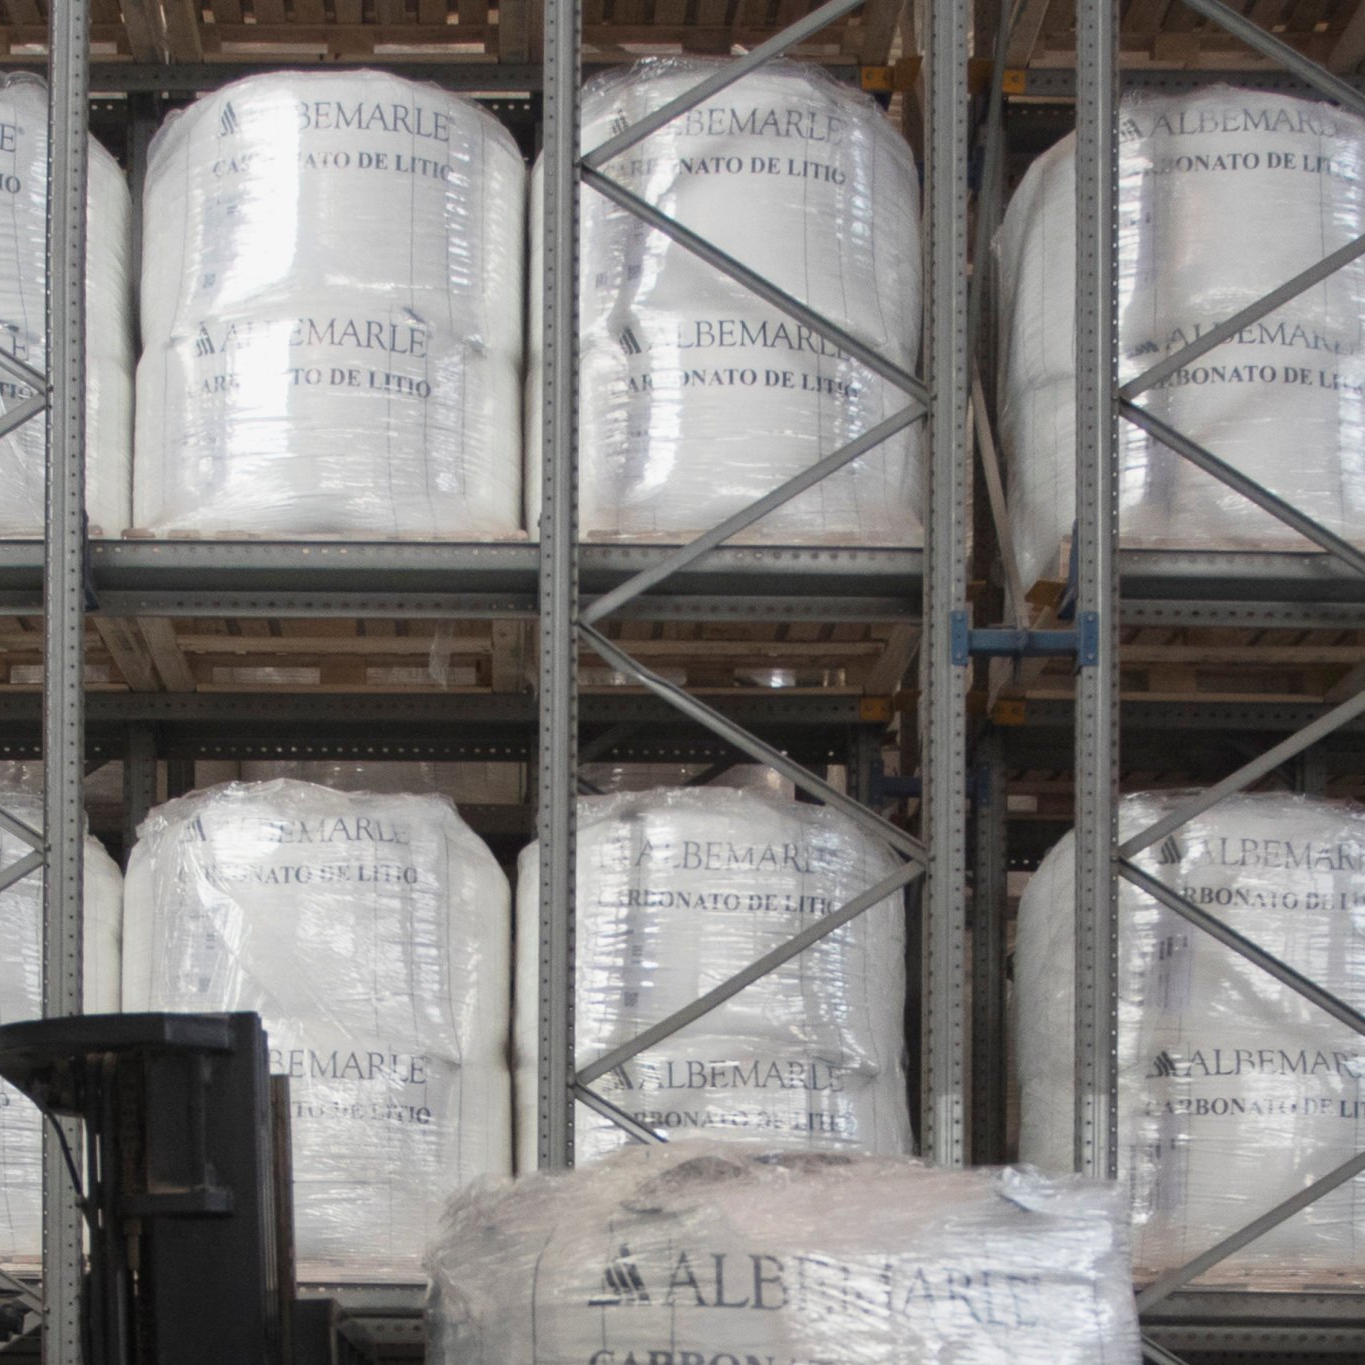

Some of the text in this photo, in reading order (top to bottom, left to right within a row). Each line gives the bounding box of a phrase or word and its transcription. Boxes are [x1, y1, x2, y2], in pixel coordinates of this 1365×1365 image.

[297, 101, 451, 141] BEMARLE
[675, 107, 845, 145] BEMARLE
[1149, 106, 1335, 139] ALBEMAR
[358, 153, 388, 171] DE
[394, 154, 456, 182] LITIO
[750, 157, 847, 185] DE LITIO
[1267, 152, 1297, 170] DE
[220, 318, 428, 360] AEMARLE
[677, 319, 850, 362] LBEMARL
[329, 367, 361, 387] DE
[367, 369, 432, 400] LITIO
[764, 370, 795, 389] DE
[1150, 365, 1317, 390] BONATO DE
[357, 865, 418, 885] LITIO
[598, 889, 741, 911] RBONATO
[748, 894, 779, 912] DE
[1179, 888, 1299, 911] RBONATO
[269, 1049, 428, 1084] BEMARLE
